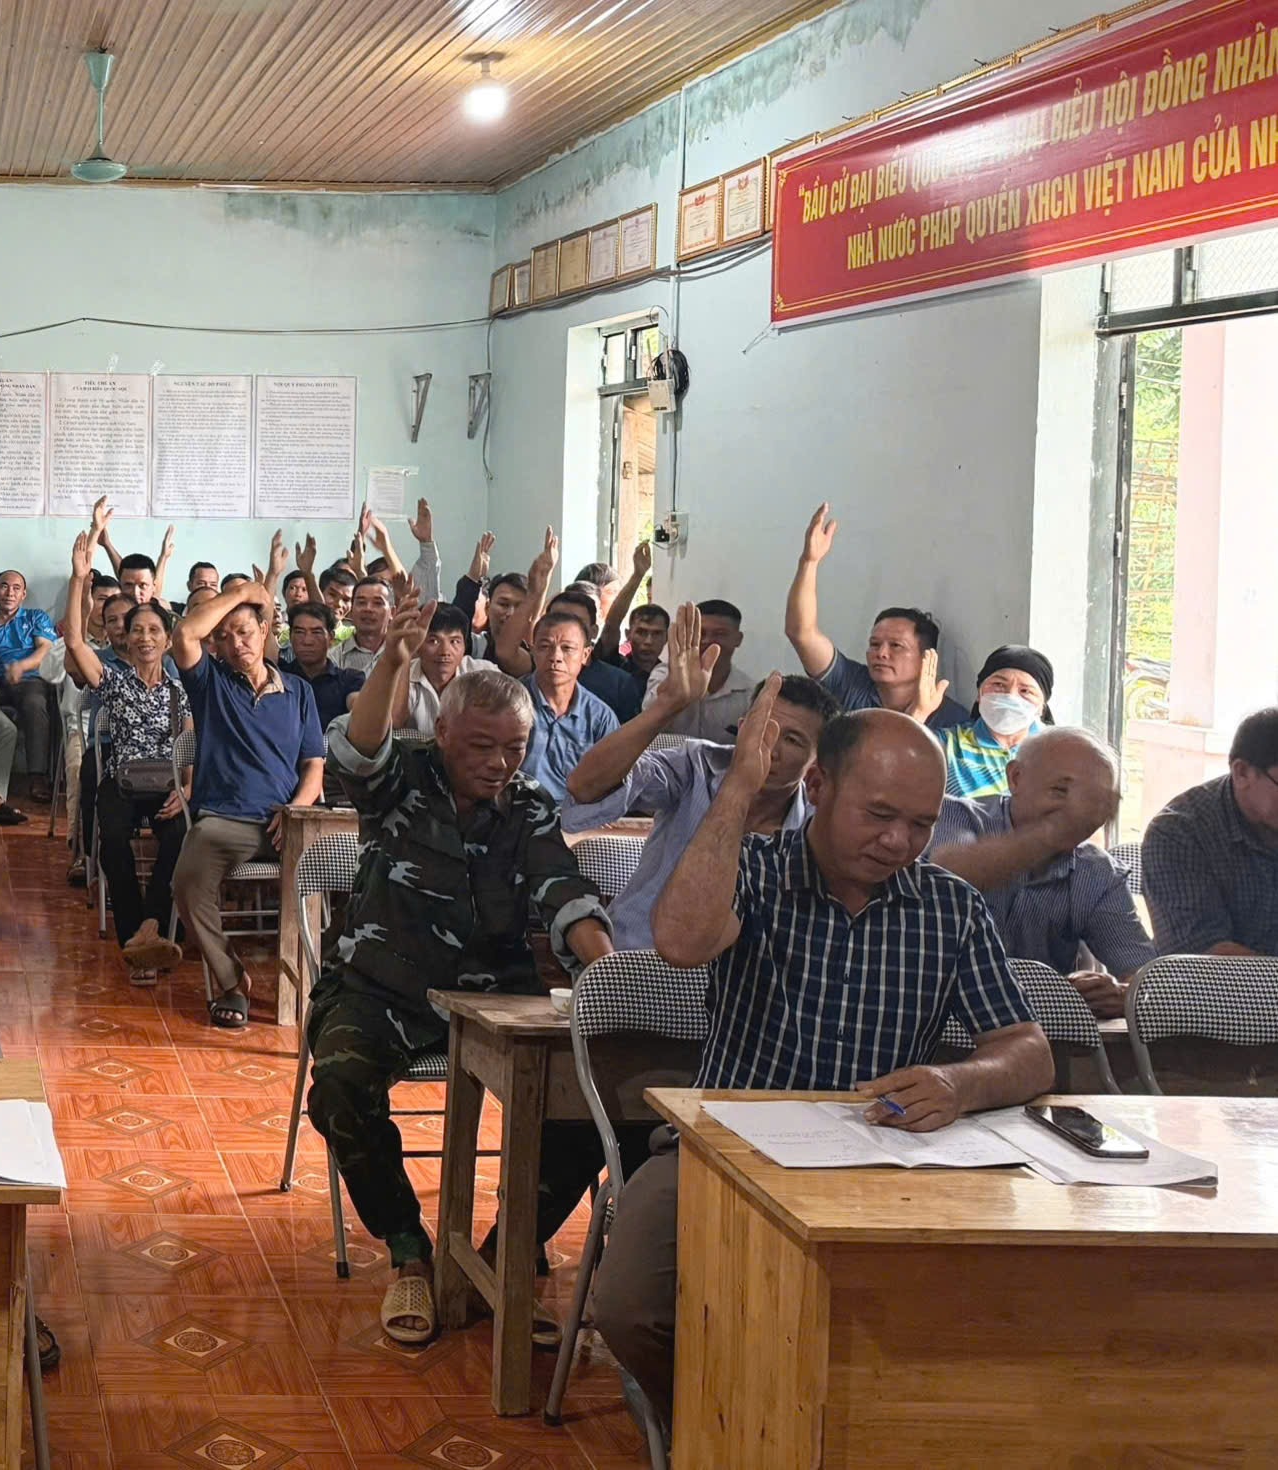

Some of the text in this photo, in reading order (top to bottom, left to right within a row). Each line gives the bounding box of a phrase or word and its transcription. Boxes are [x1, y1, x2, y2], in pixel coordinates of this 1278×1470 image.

[830, 166, 851, 213] CỬ
[850, 169, 873, 213] ĐẠI
[875, 144, 908, 200] BIỂU
[1050, 77, 1097, 145] BIỂU
[1101, 70, 1138, 135] HỘI
[1142, 48, 1208, 117] ĐỒNG
[847, 223, 874, 270] NHÀ
[878, 213, 916, 262] NƯỚC
[920, 200, 961, 252] PHÁP
[965, 178, 1020, 244] QUYỀN
[1025, 172, 1078, 227] XHCN
[1083, 152, 1127, 216] VIỆT
[1132, 141, 1185, 200] NAM
[1192, 113, 1242, 184] CỦA
